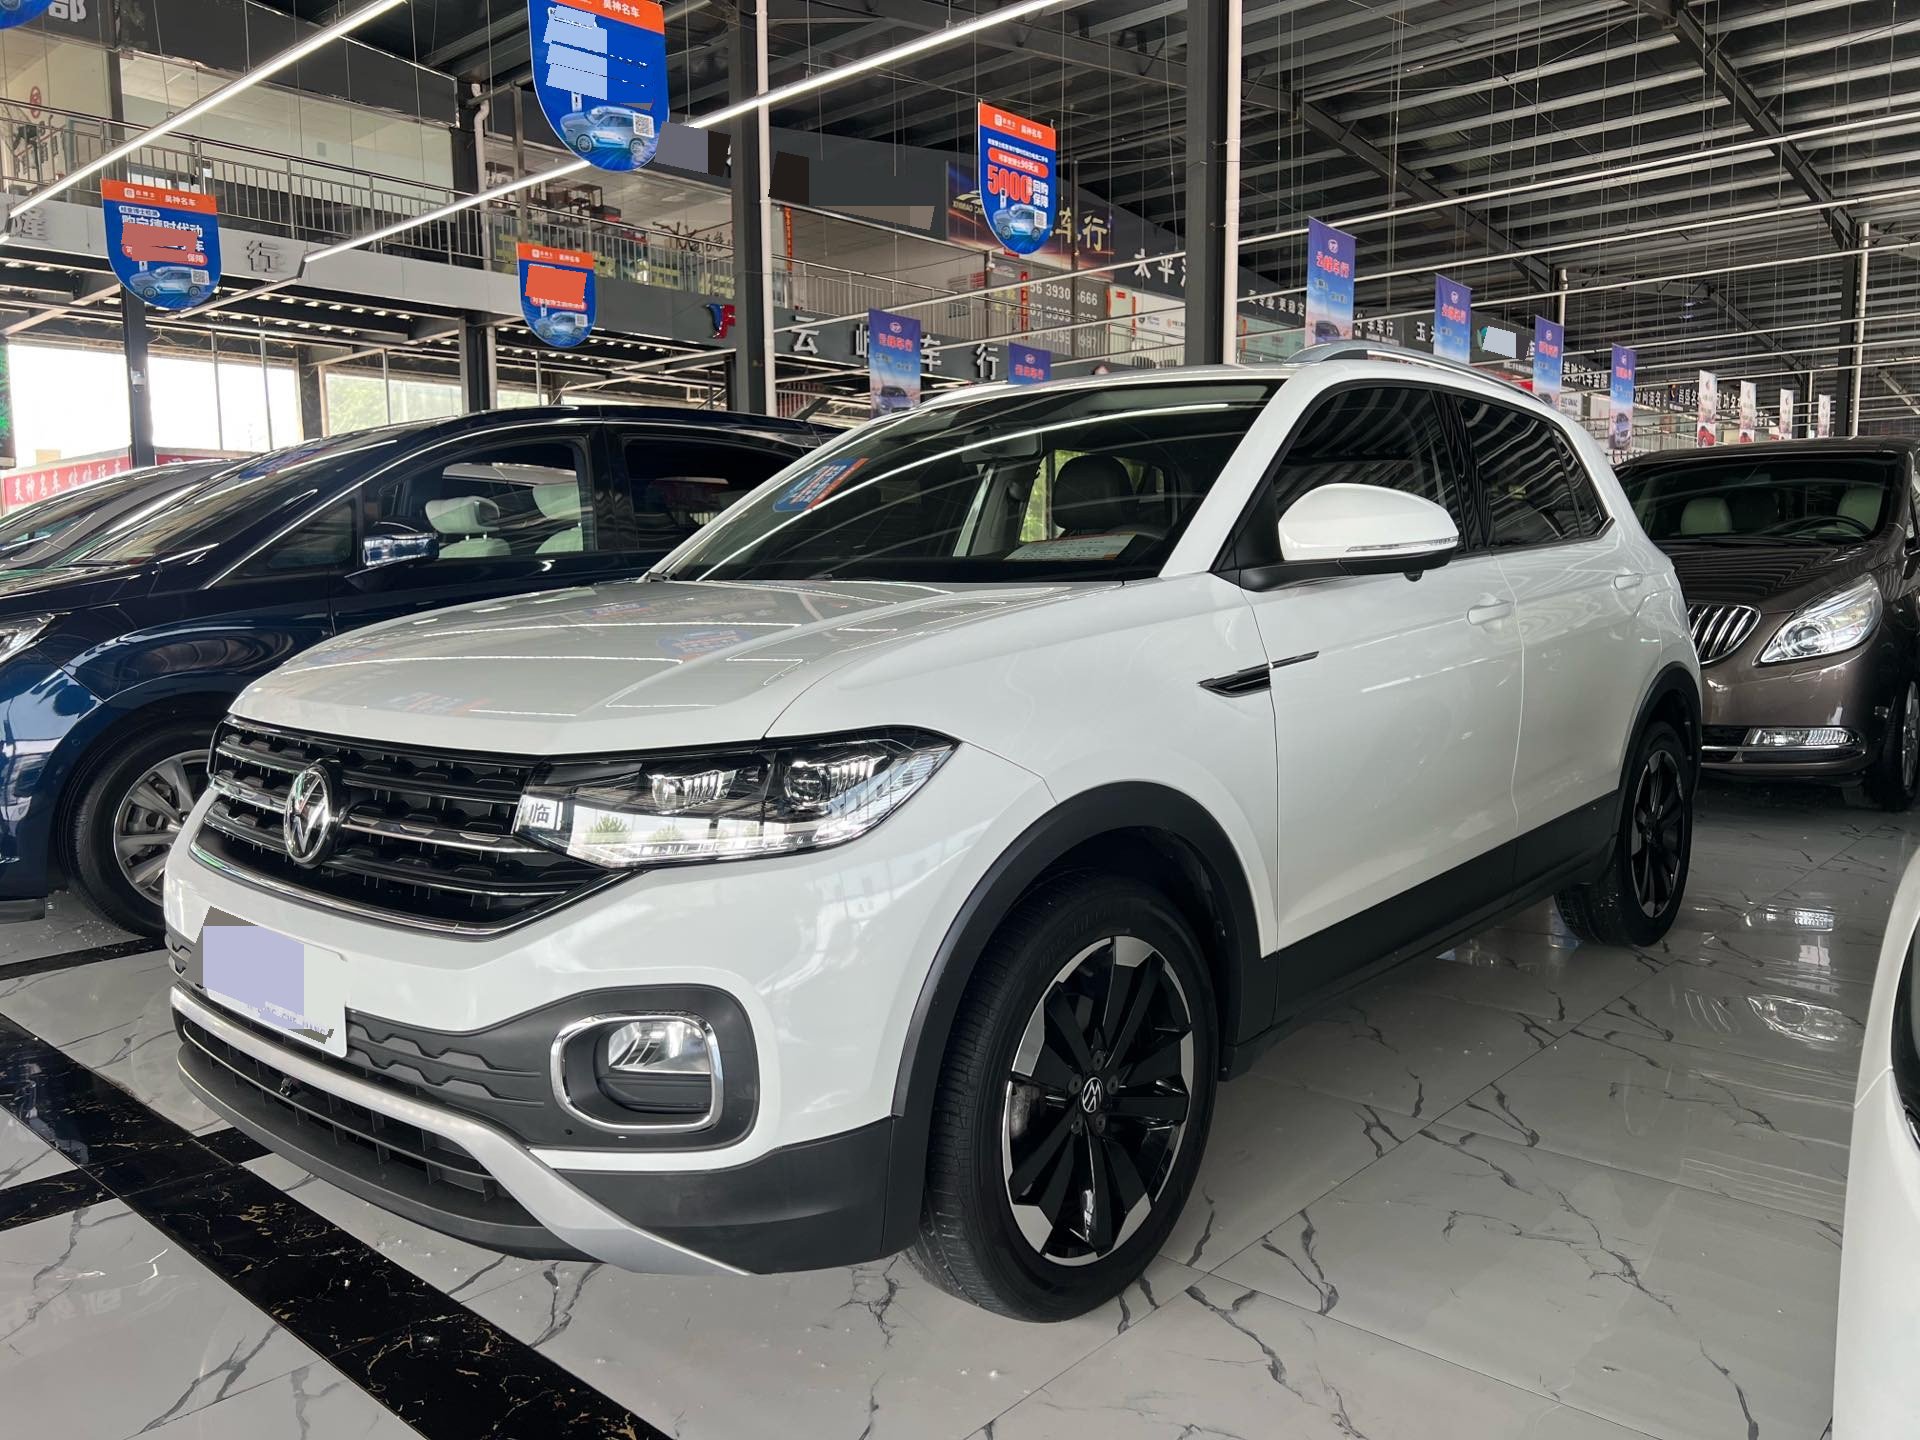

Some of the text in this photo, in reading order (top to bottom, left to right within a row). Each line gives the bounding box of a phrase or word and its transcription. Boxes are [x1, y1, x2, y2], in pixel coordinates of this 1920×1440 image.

[1133, 248, 1186, 287] 太平
[1045, 283, 1071, 300] 3930
[1077, 289, 1098, 306] 666
